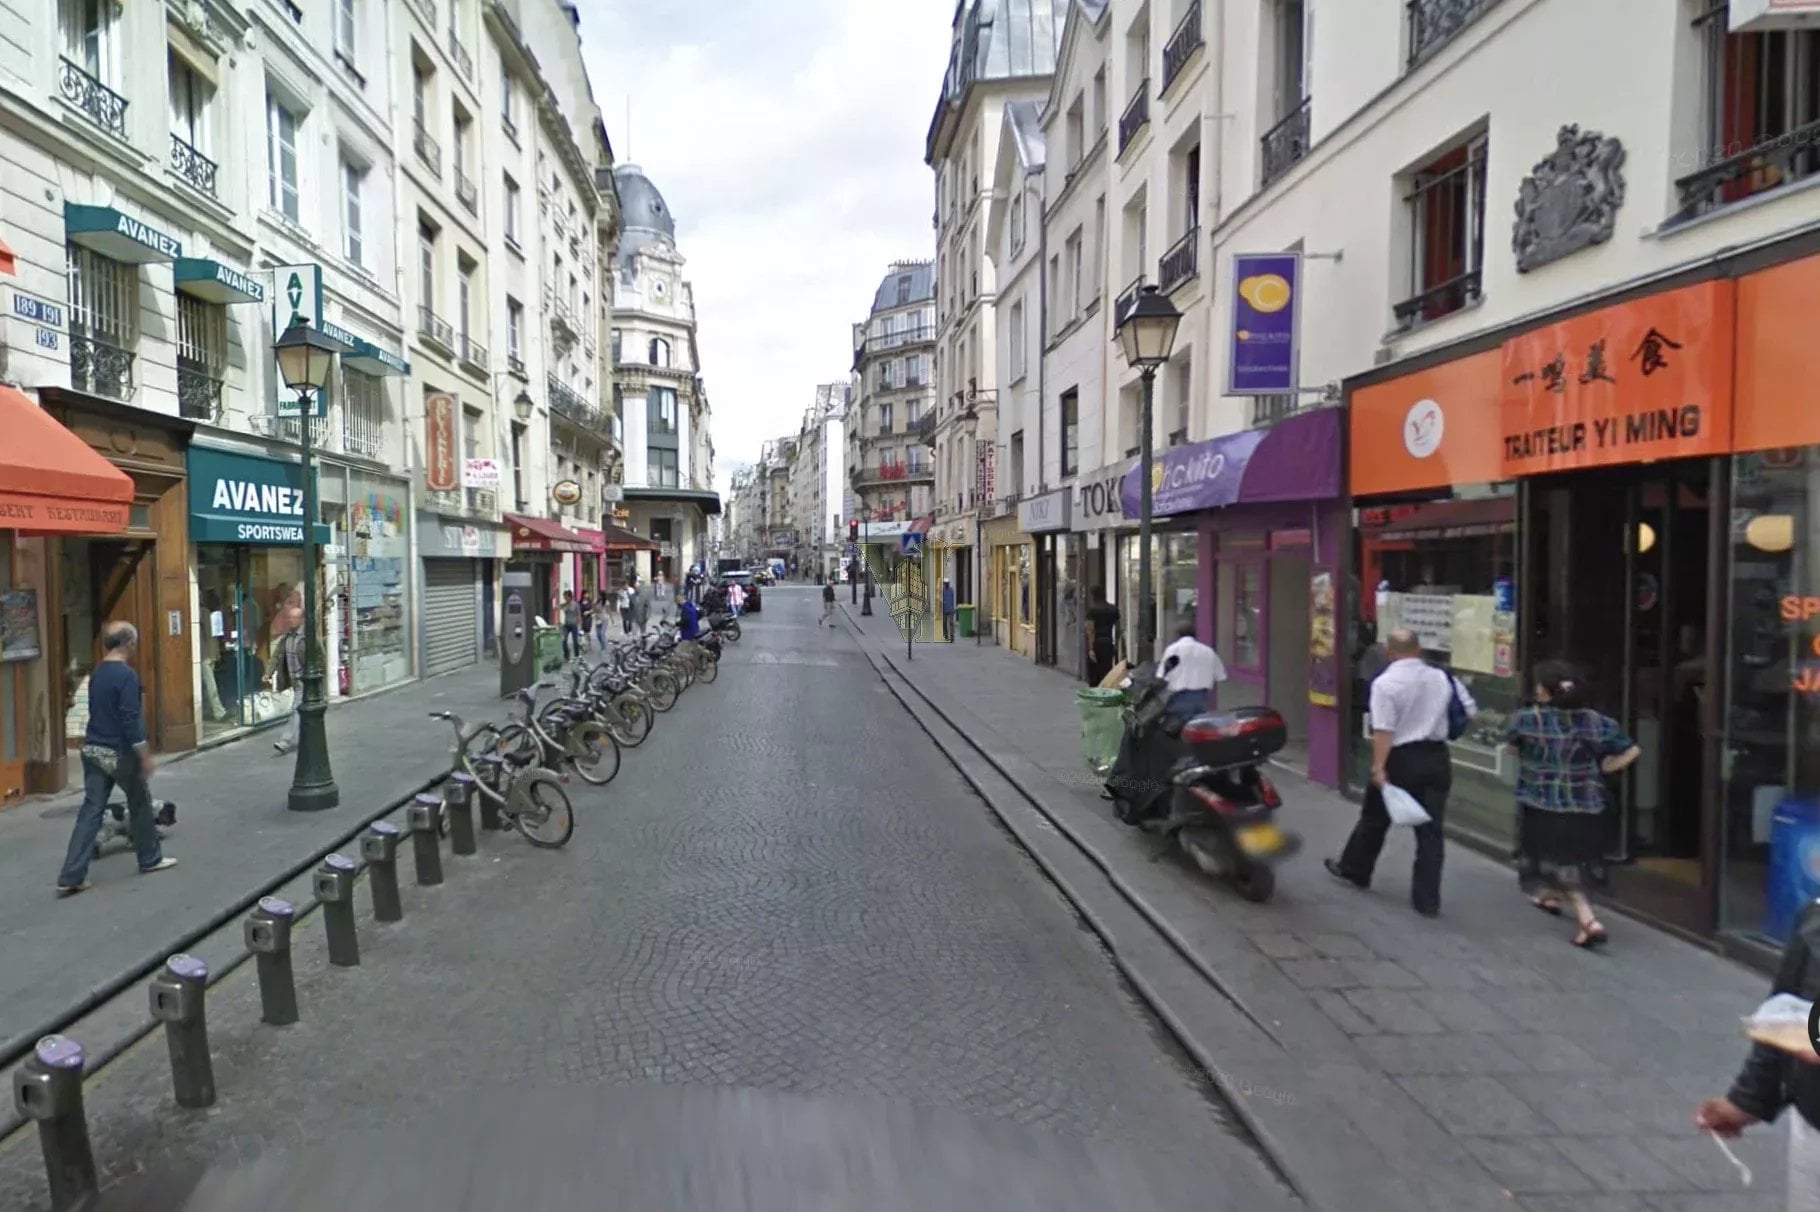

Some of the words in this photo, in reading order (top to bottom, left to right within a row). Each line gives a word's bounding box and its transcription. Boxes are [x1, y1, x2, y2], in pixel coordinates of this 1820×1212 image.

[117, 215, 179, 258] AVANEZ
[216, 266, 262, 300] AVANEZ
[15, 296, 37, 317] 189
[42, 304, 60, 325] 191
[36, 328, 58, 351] 193
[322, 321, 355, 347] AVANEZ
[1504, 422, 1586, 462] TRAITEUR
[1593, 417, 1617, 449] YI
[1625, 404, 1700, 445] MING
[213, 479, 304, 516] AVANEZ
[238, 524, 304, 542] SPORTSWEA
